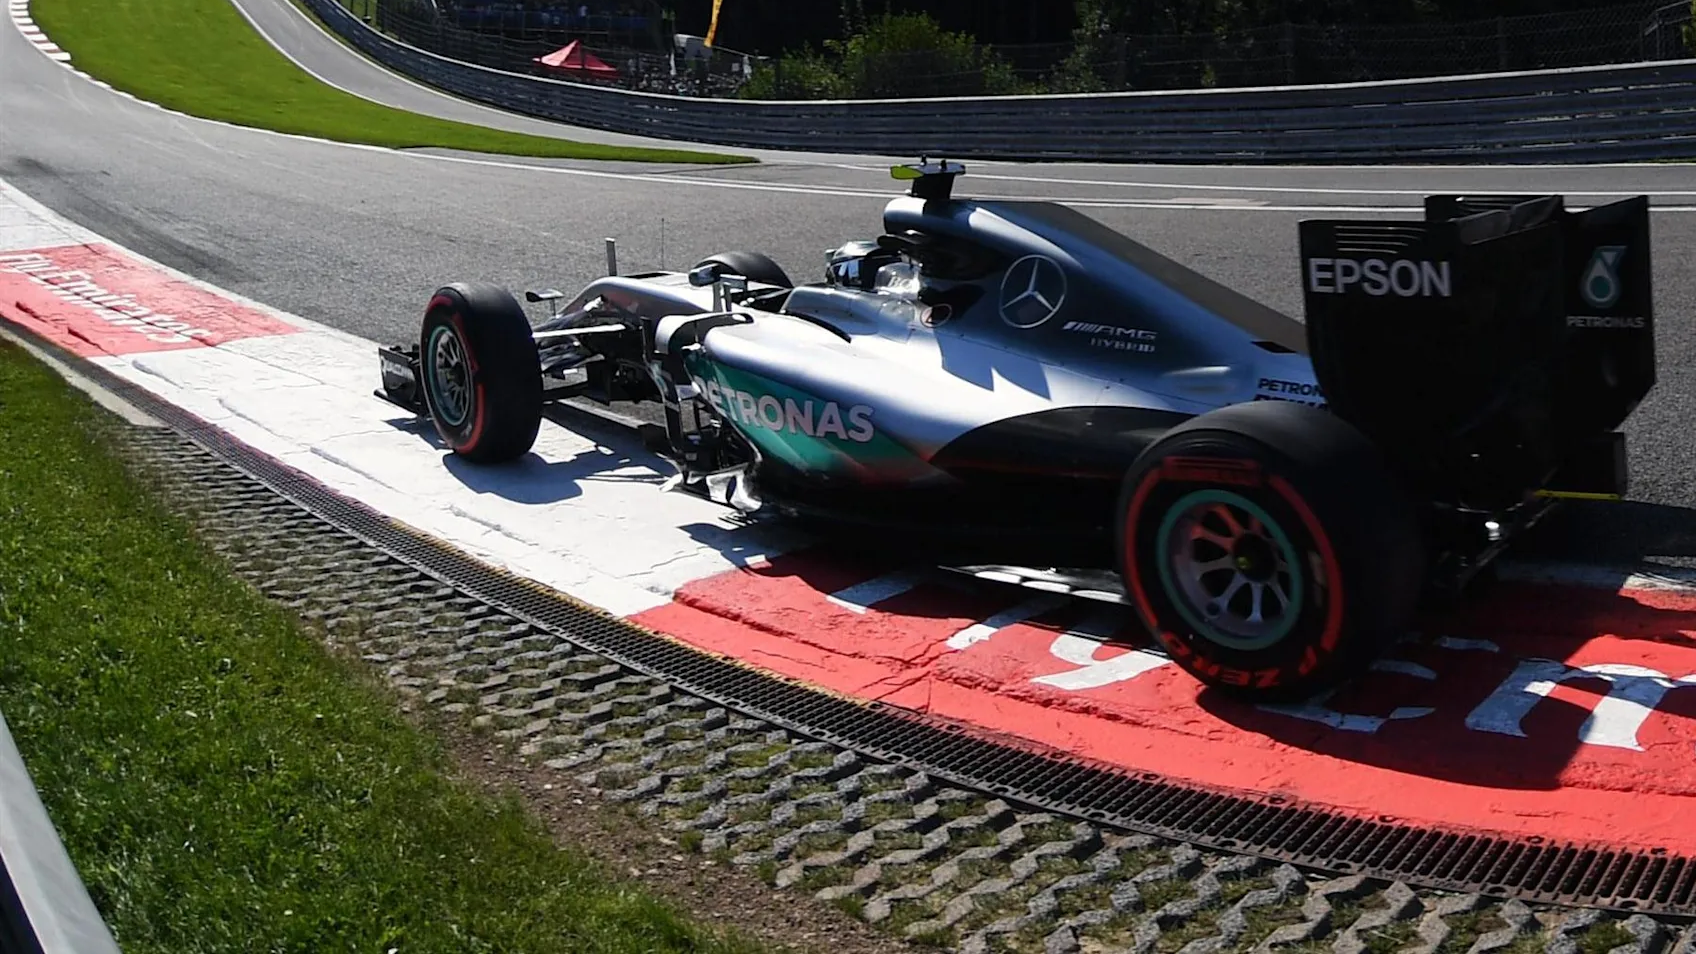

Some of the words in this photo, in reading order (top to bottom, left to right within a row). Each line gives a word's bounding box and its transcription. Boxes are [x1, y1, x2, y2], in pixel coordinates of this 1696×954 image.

[1309, 257, 1452, 297] EPSON
[1565, 315, 1645, 329] PETRONAS
[1095, 325, 1158, 341] AMG
